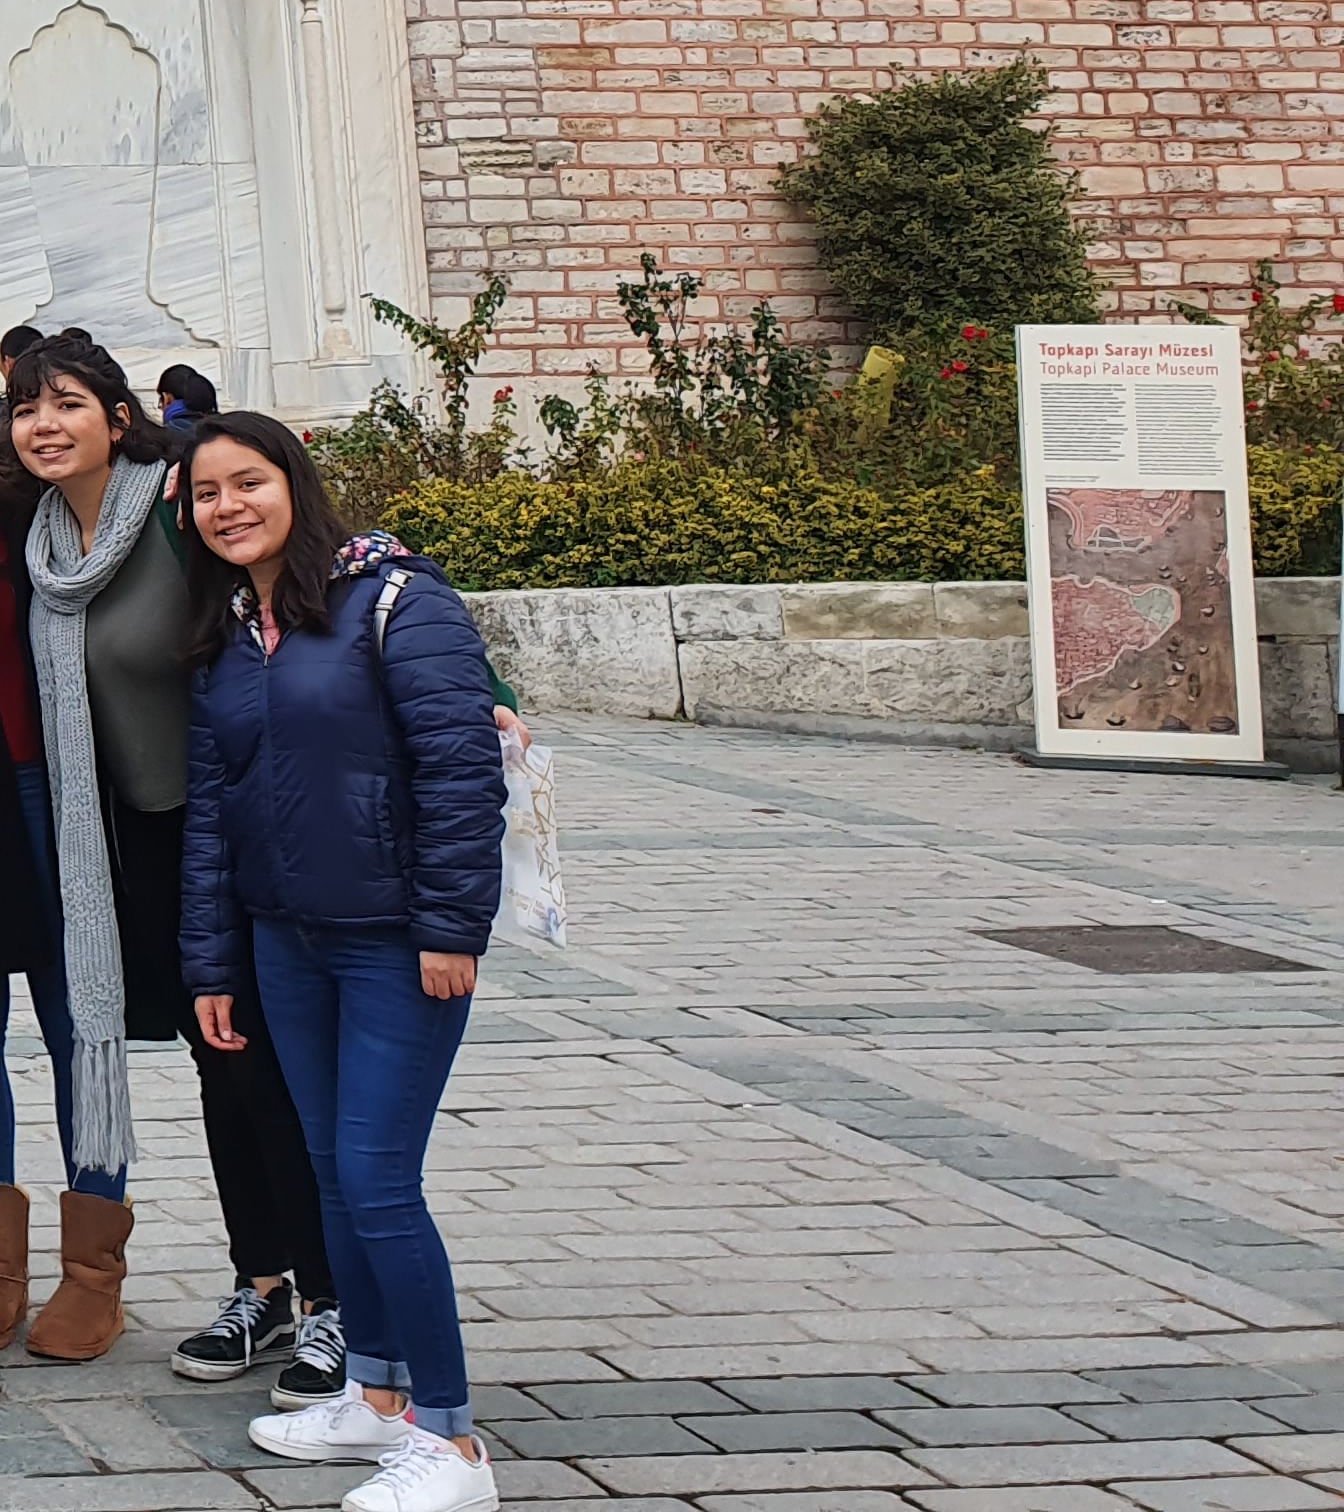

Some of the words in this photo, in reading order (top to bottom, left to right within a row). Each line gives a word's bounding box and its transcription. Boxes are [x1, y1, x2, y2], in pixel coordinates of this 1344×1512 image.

[1038, 343, 1099, 360] Topkapı
[1104, 343, 1153, 360] Sarayı
[1159, 343, 1214, 357] Müzesi
[1102, 362, 1151, 376] Palace
[1156, 362, 1219, 376] Museum
